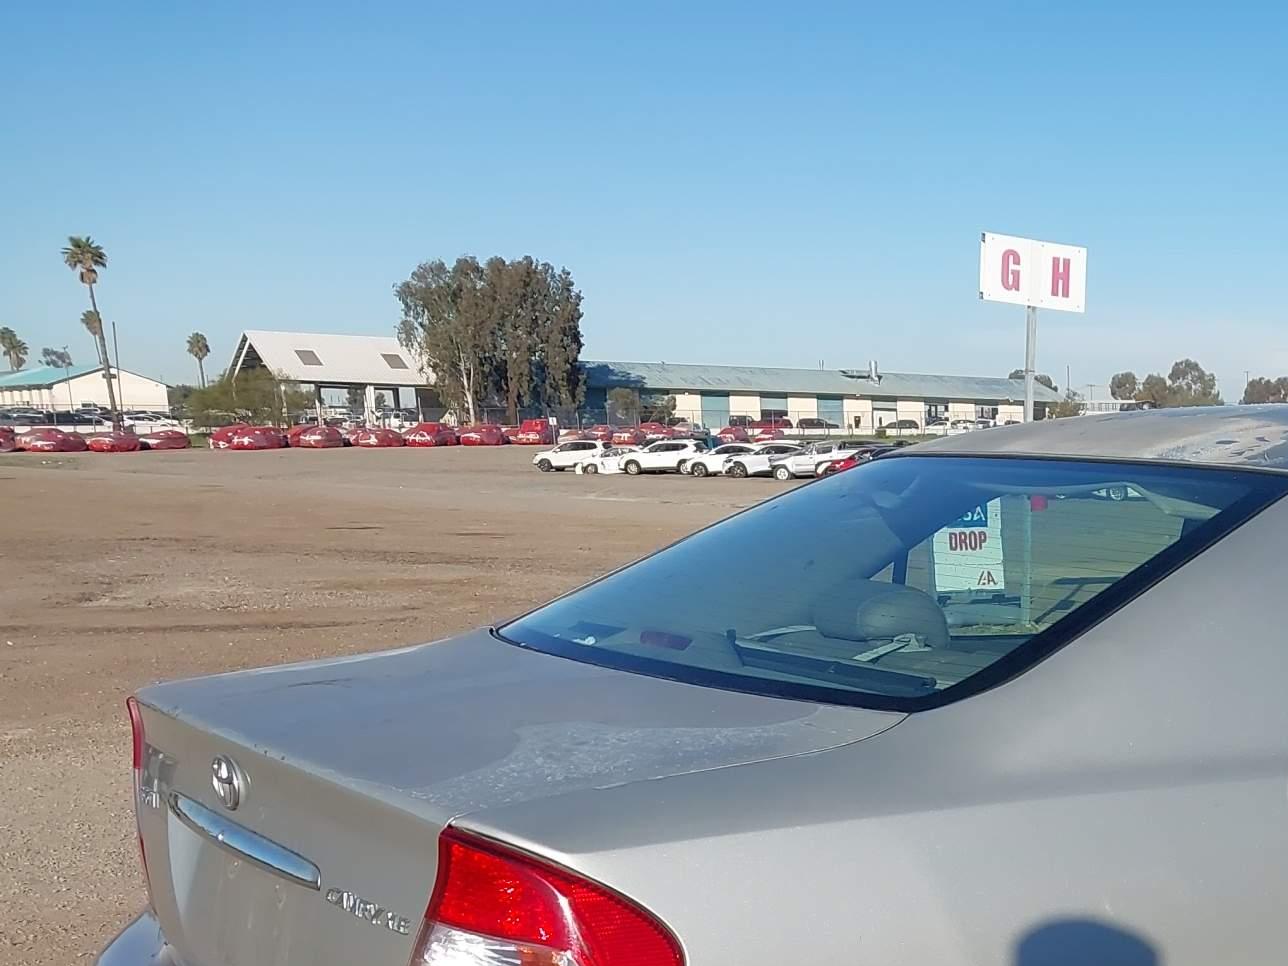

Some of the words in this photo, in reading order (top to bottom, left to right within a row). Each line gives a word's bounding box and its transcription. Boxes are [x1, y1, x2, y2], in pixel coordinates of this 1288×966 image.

[1001, 249, 1020, 292] G
[1051, 256, 1070, 298] H
[948, 531, 987, 551] DROP
